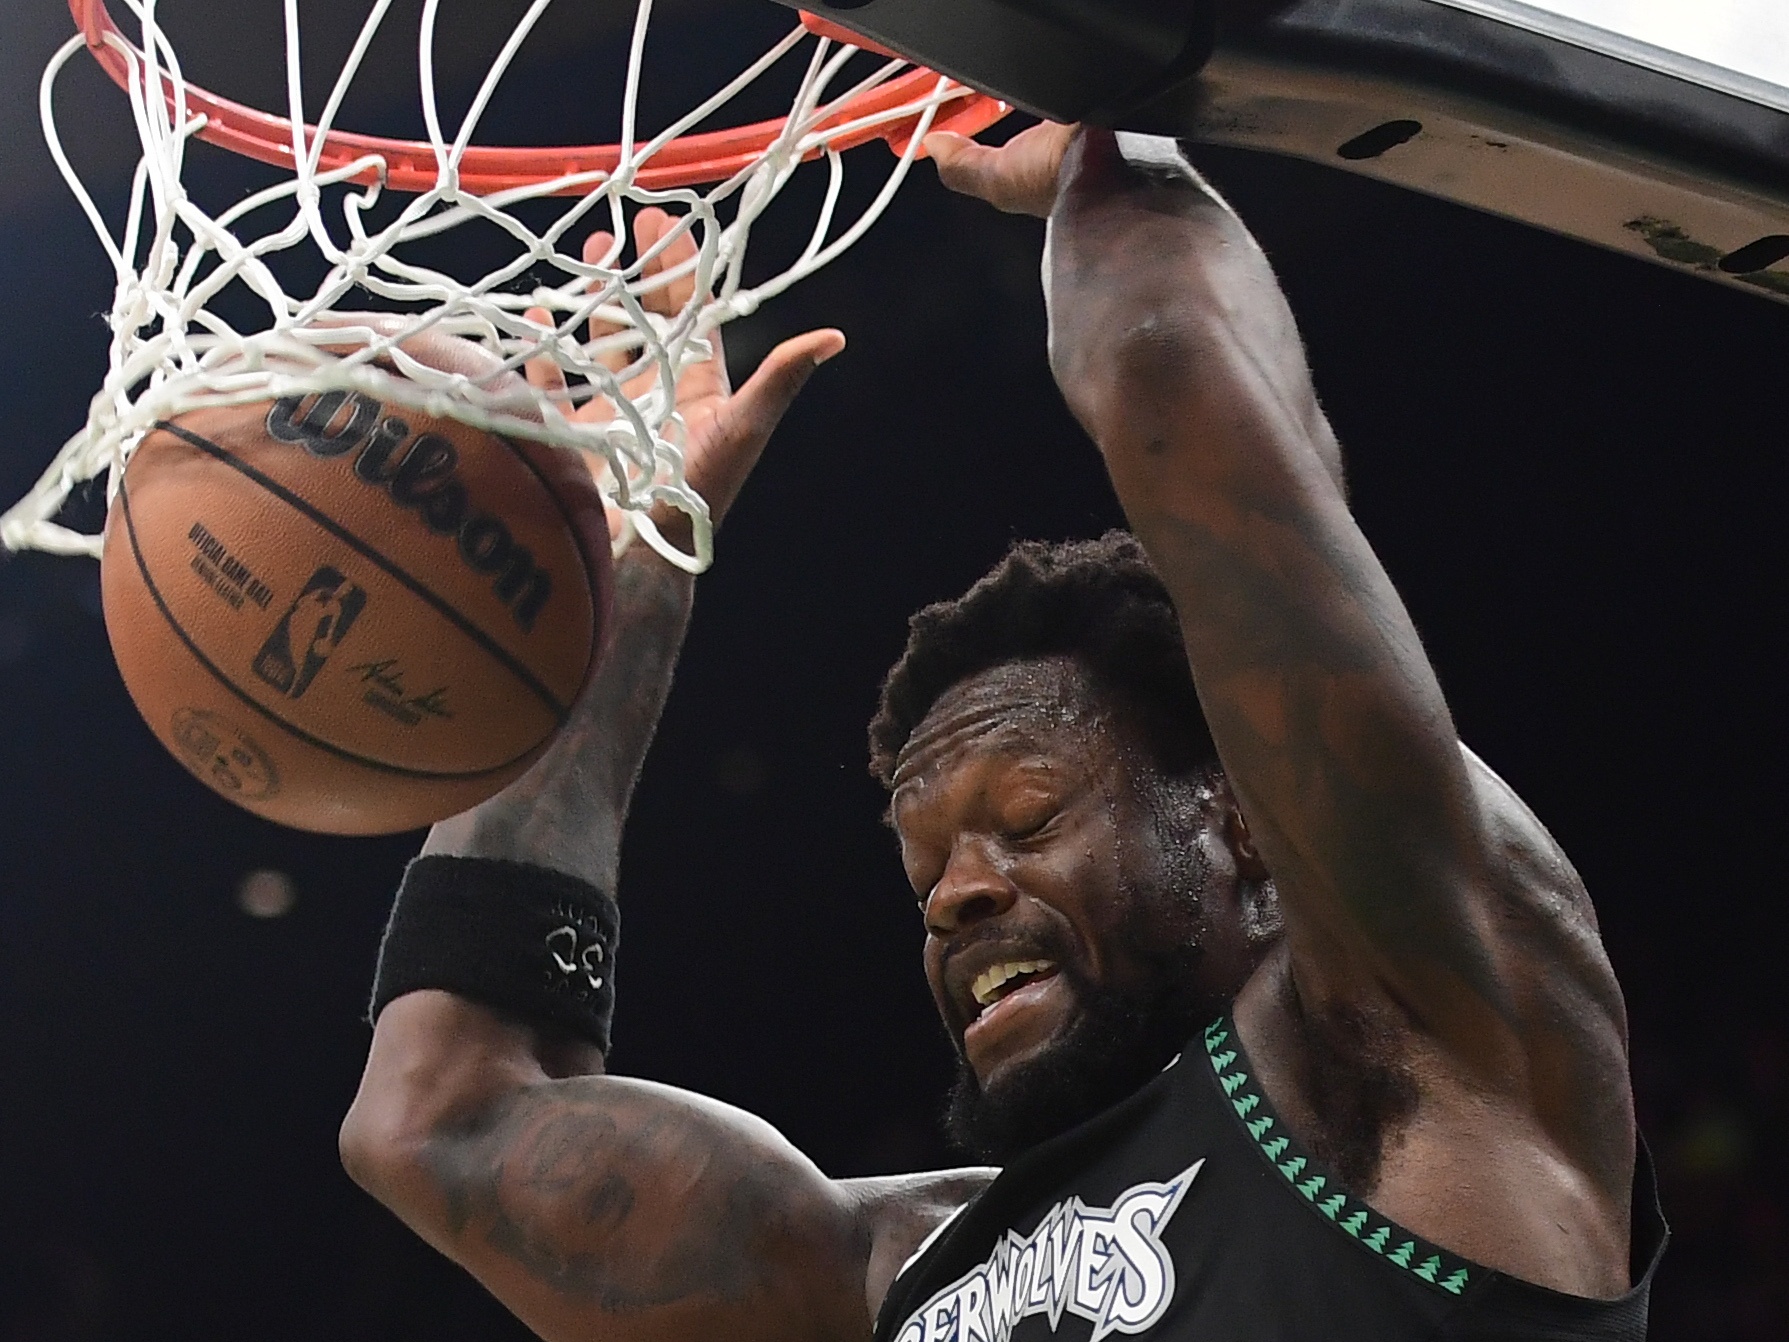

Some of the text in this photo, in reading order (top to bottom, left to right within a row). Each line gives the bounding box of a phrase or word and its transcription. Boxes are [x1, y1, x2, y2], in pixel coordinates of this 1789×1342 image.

[188, 521, 227, 567] OFFICIAL
[221, 555, 252, 589] GAME
[246, 577, 274, 612] BALL
[266, 389, 554, 635] Wilson
